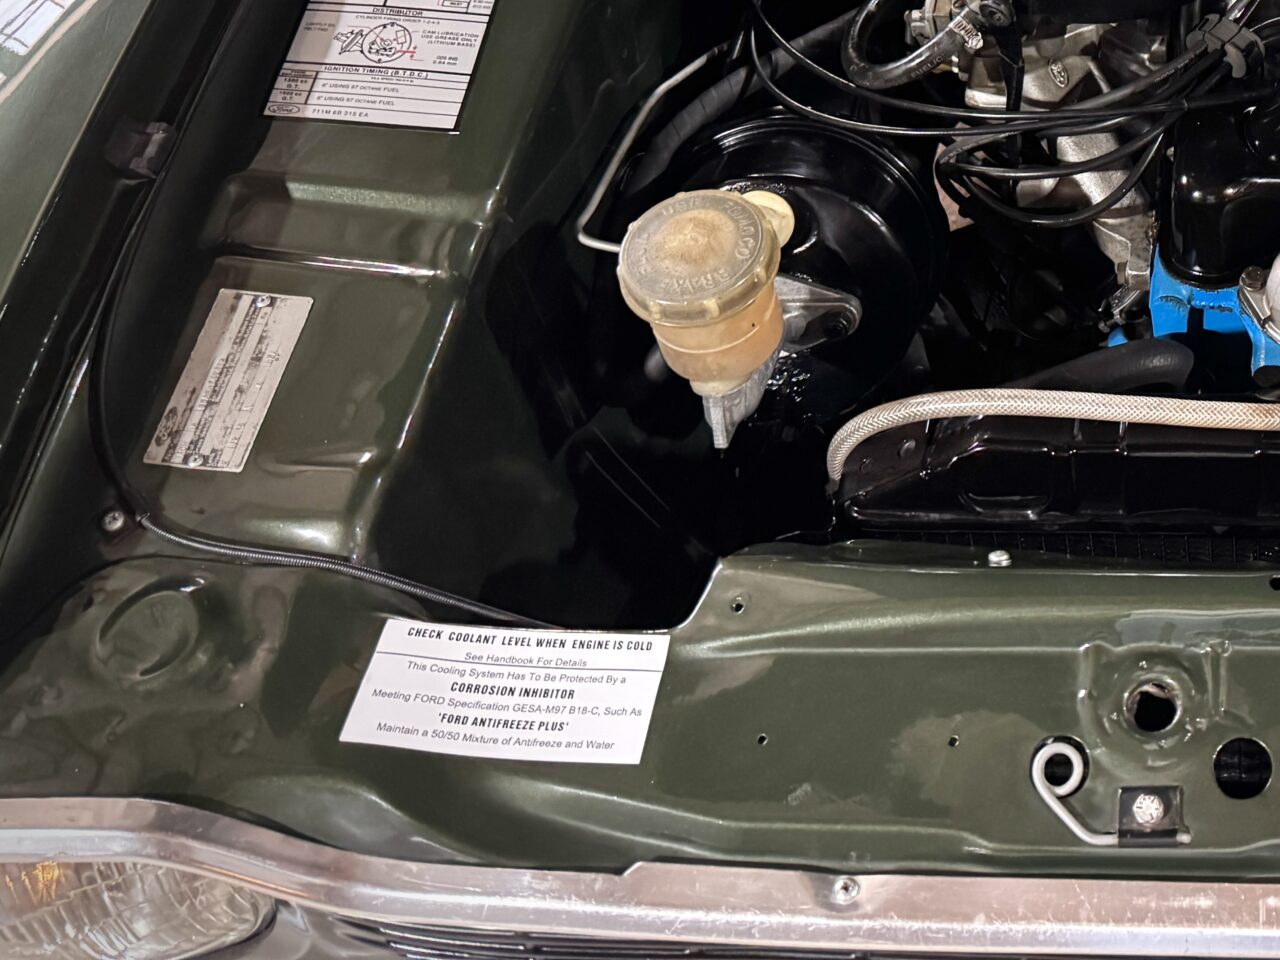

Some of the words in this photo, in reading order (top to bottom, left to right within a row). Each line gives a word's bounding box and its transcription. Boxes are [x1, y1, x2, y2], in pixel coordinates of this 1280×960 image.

[373, 8, 423, 16] DISTRIBUTOR
[324, 65, 359, 73] IGNITION
[407, 627, 444, 640] CHECK
[448, 632, 497, 645] COOLANT
[501, 635, 532, 647] LEVEL
[536, 638, 567, 649] WHEN
[572, 639, 610, 650] ENGINE
[613, 640, 623, 650] IS
[627, 641, 653, 651] COLD
[464, 652, 483, 661] See
[485, 654, 533, 665] Handbook
[536, 657, 552, 666] For
[555, 658, 587, 667] Details
[407, 660, 427, 672] This
[429, 664, 466, 678] Cooling
[468, 668, 504, 681] System
[506, 672, 526, 681] Has
[530, 673, 541, 681] To
[543, 674, 557, 683] Be
[559, 674, 603, 684] Protected
[606, 675, 619, 686] By
[450, 681, 516, 697] CORROSION
[519, 687, 575, 700] INHIBITOR
[371, 688, 411, 703] Meeting
[414, 693, 446, 705] FORD
[447, 698, 510, 712] Specification
[513, 703, 566, 715] GESA-M97
[568, 706, 601, 717] B18-C,
[603, 707, 628, 716] Such
[629, 708, 642, 717] As
[438, 712, 469, 726] 'FORD
[471, 716, 536, 731] ANTIFREEZE
[376, 722, 419, 736] Maintain
[431, 729, 460, 740] 50/50
[462, 732, 499, 746] Mixture
[501, 736, 512, 746] of
[513, 736, 562, 748] Antifreeze
[565, 740, 583, 749] and
[586, 740, 615, 750] Water
